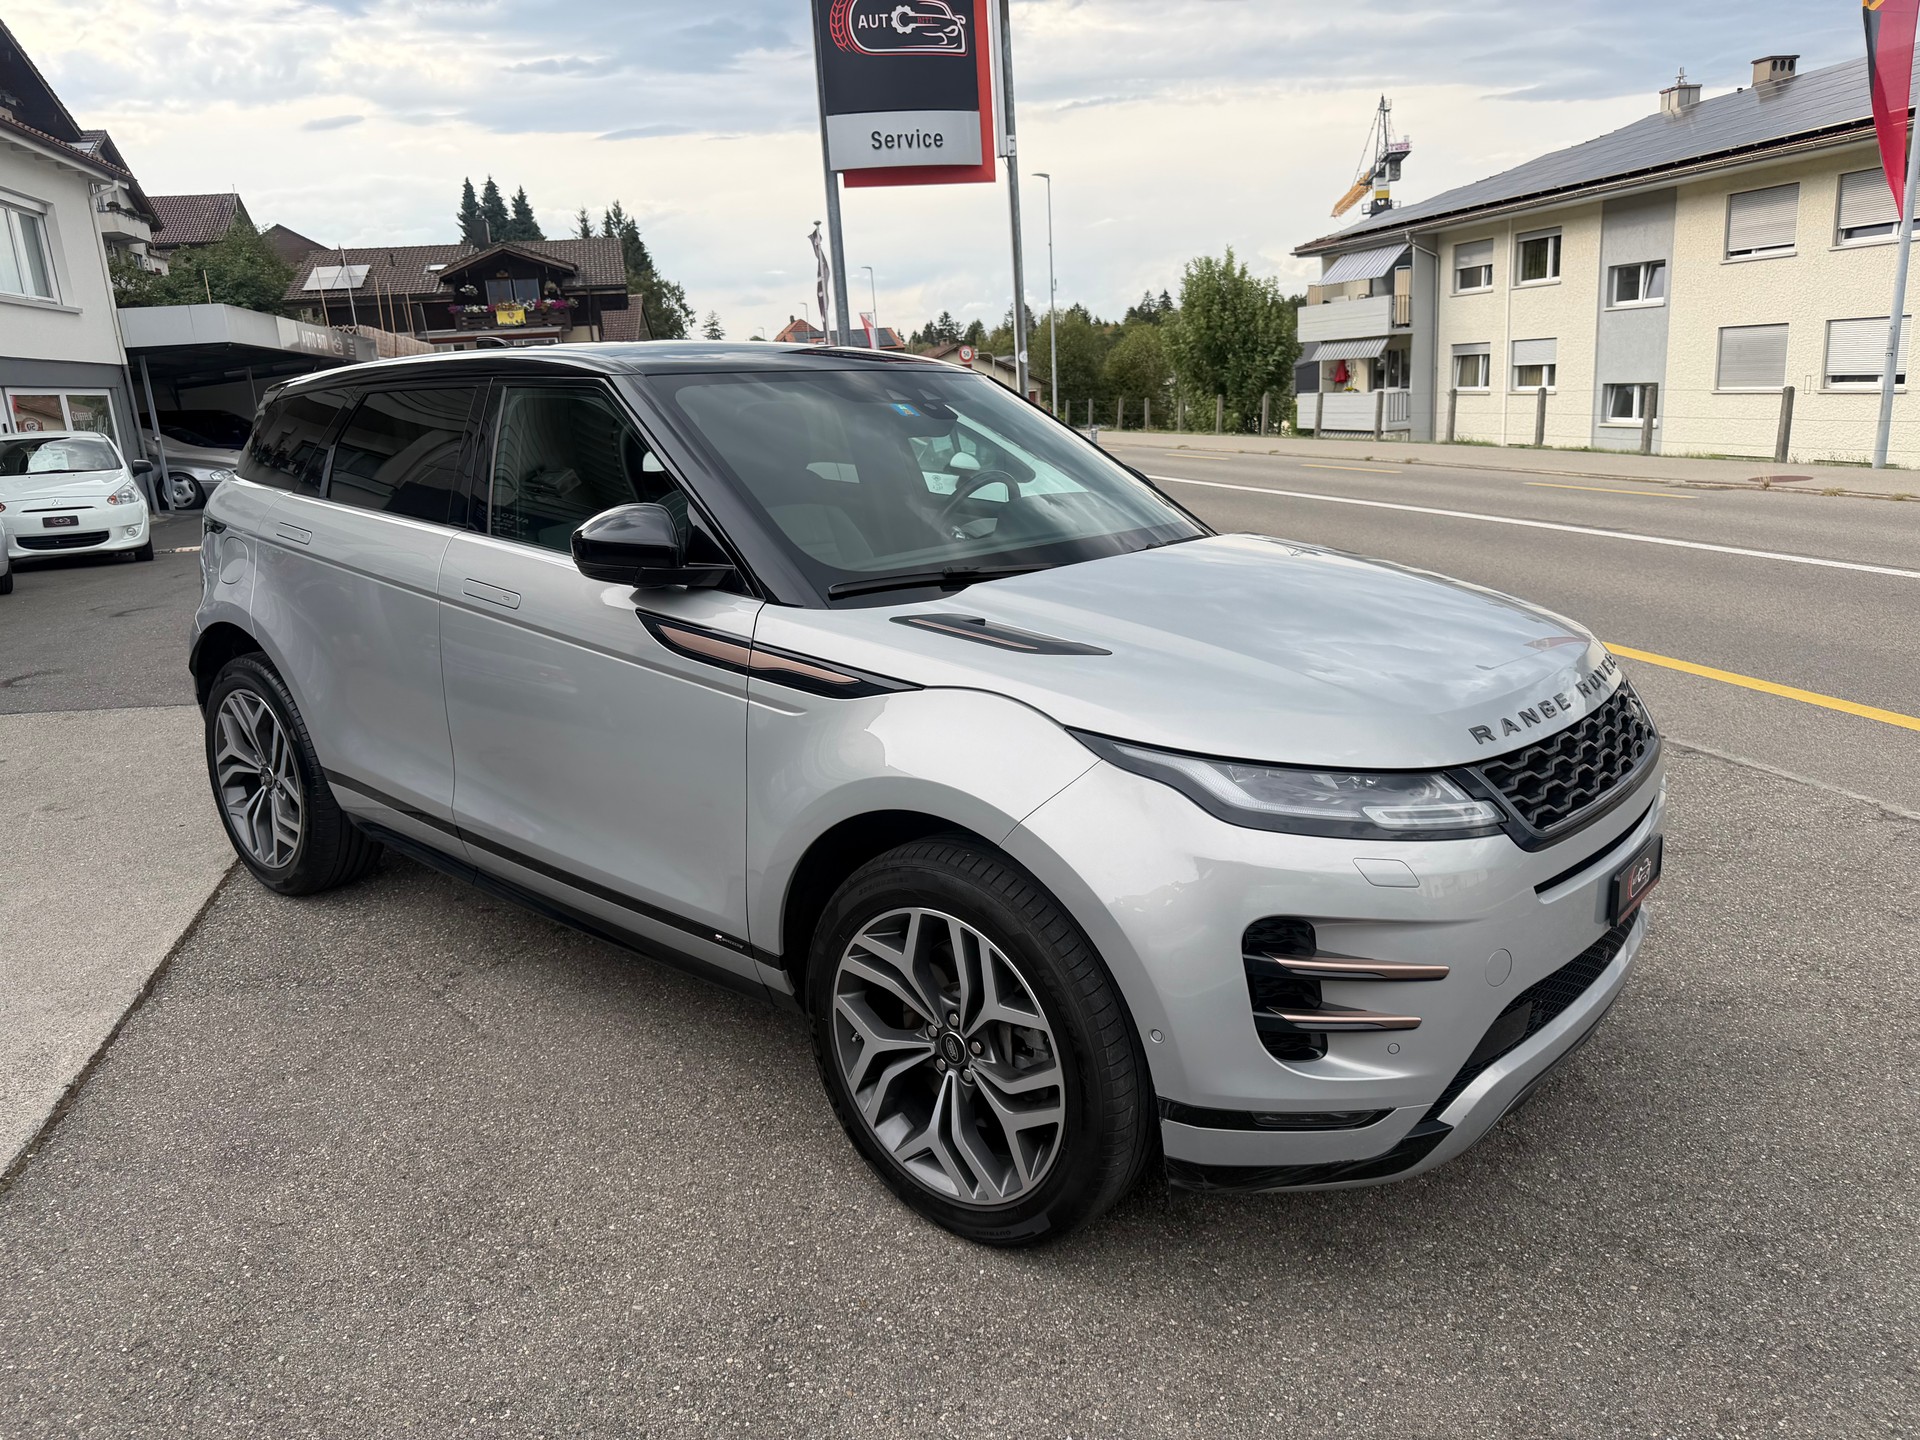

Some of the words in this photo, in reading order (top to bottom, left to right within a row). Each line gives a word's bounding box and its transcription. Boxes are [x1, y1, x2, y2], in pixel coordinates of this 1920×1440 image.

[871, 129, 944, 150] Service
[1468, 692, 1572, 745] RANGE
[1575, 653, 1617, 698] ROVER
